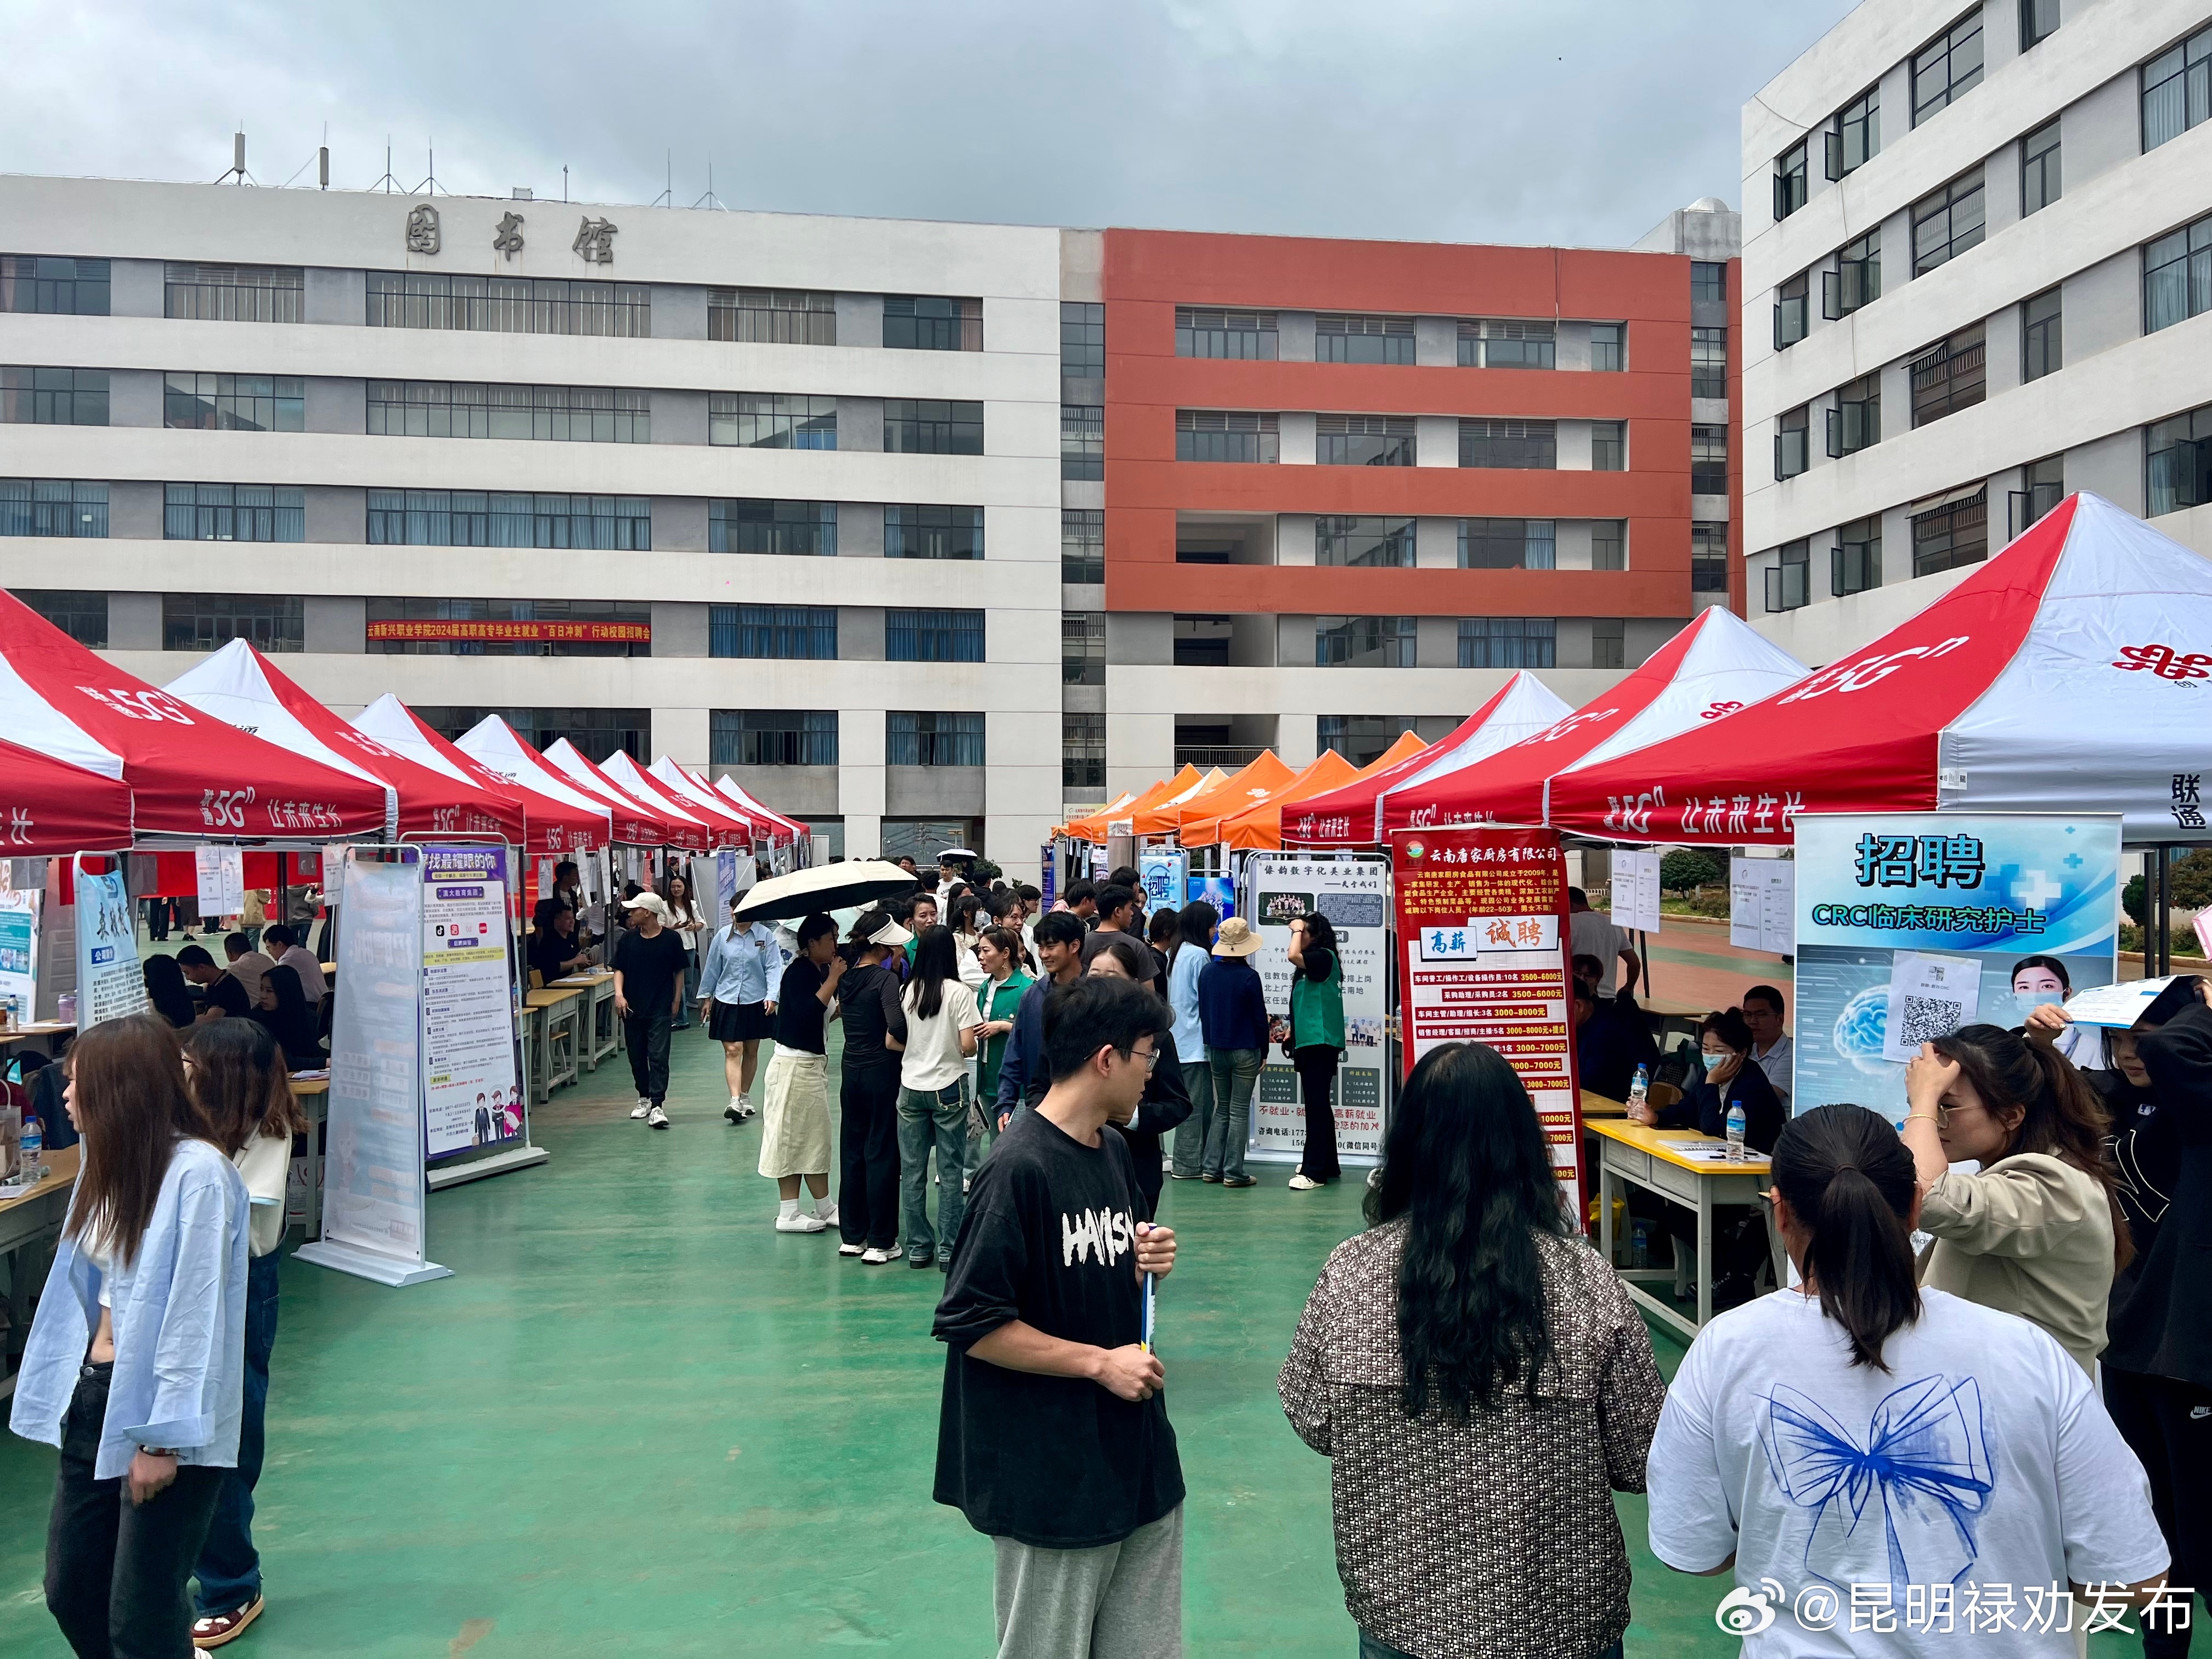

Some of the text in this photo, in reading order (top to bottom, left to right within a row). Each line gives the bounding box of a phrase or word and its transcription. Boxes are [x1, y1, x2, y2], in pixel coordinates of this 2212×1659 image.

[405, 204, 618, 265] 图书馆
[2171, 774, 2207, 830] 联通
[267, 799, 342, 827] 让未来生长
[1681, 792, 1805, 833] 让未来生长
[0, 806, 34, 845] 长
[1430, 848, 1558, 864] 云南唐家厨房有限公司
[1855, 833, 1985, 889] 招聘
[1812, 904, 2047, 935] CRC临床研究护士
[1486, 917, 1543, 948] 诚聘
[1431, 930, 1466, 953] 高薪
[1521, 972, 1562, 981] 3500-6000元
[1512, 989, 1562, 998] 3500-6000元
[1494, 1008, 1545, 1016] 3000-8000元
[1506, 1025, 1565, 1035] 3000-8000元+提成
[1516, 1043, 1566, 1052] 3000-7000元
[1510, 1061, 1561, 1069] 3000-7000元
[1527, 1079, 1569, 1088] 3000-7000元
[1334, 1109, 1376, 1120] 高薪就业
[1259, 1126, 1306, 1136] 咨询电话:177
[2194, 1406, 2211, 1414] NIKE
